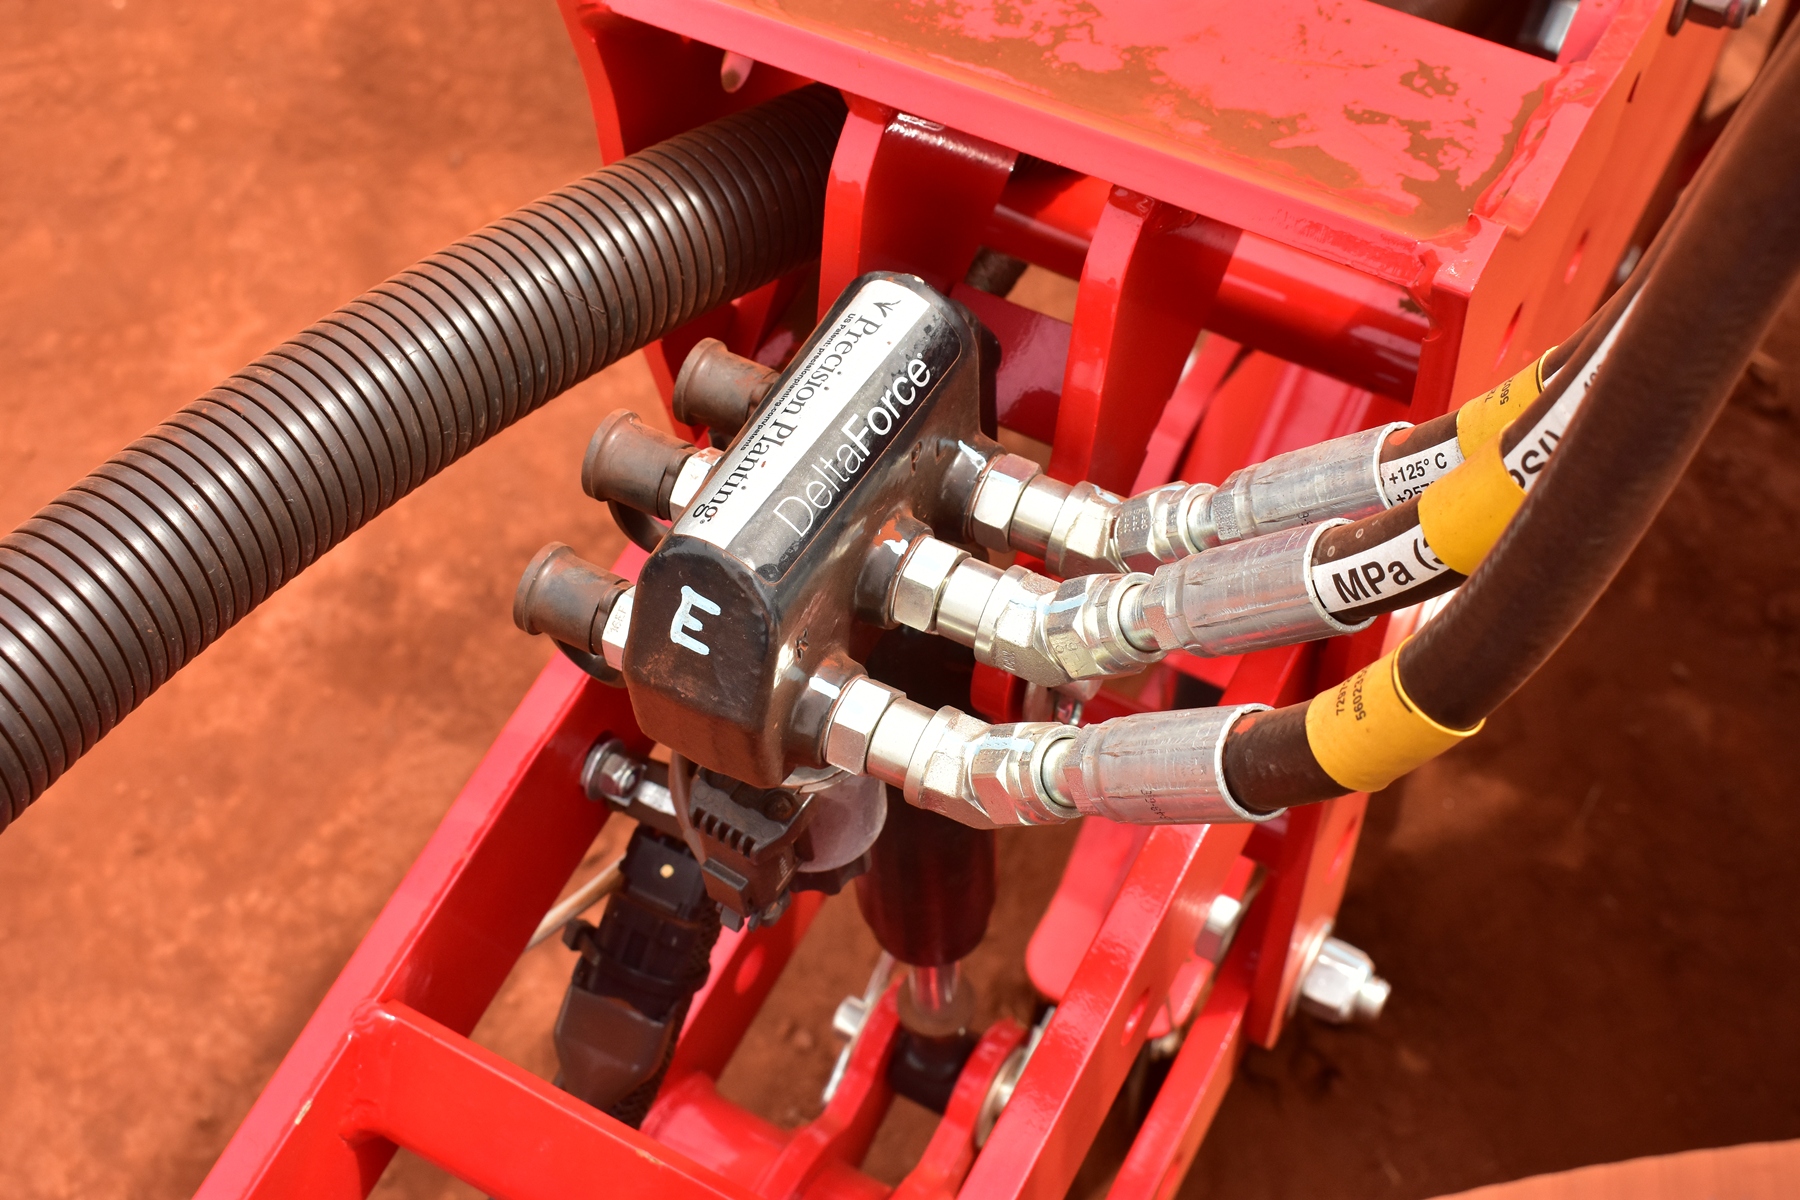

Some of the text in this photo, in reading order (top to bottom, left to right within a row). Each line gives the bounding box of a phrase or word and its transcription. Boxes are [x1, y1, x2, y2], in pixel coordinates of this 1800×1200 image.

[843, 313, 856, 324] US
[692, 314, 882, 522] Precision Planting
[773, 358, 931, 537] DeltaForce
[1331, 560, 1417, 604] MPa
[670, 585, 721, 655] E
